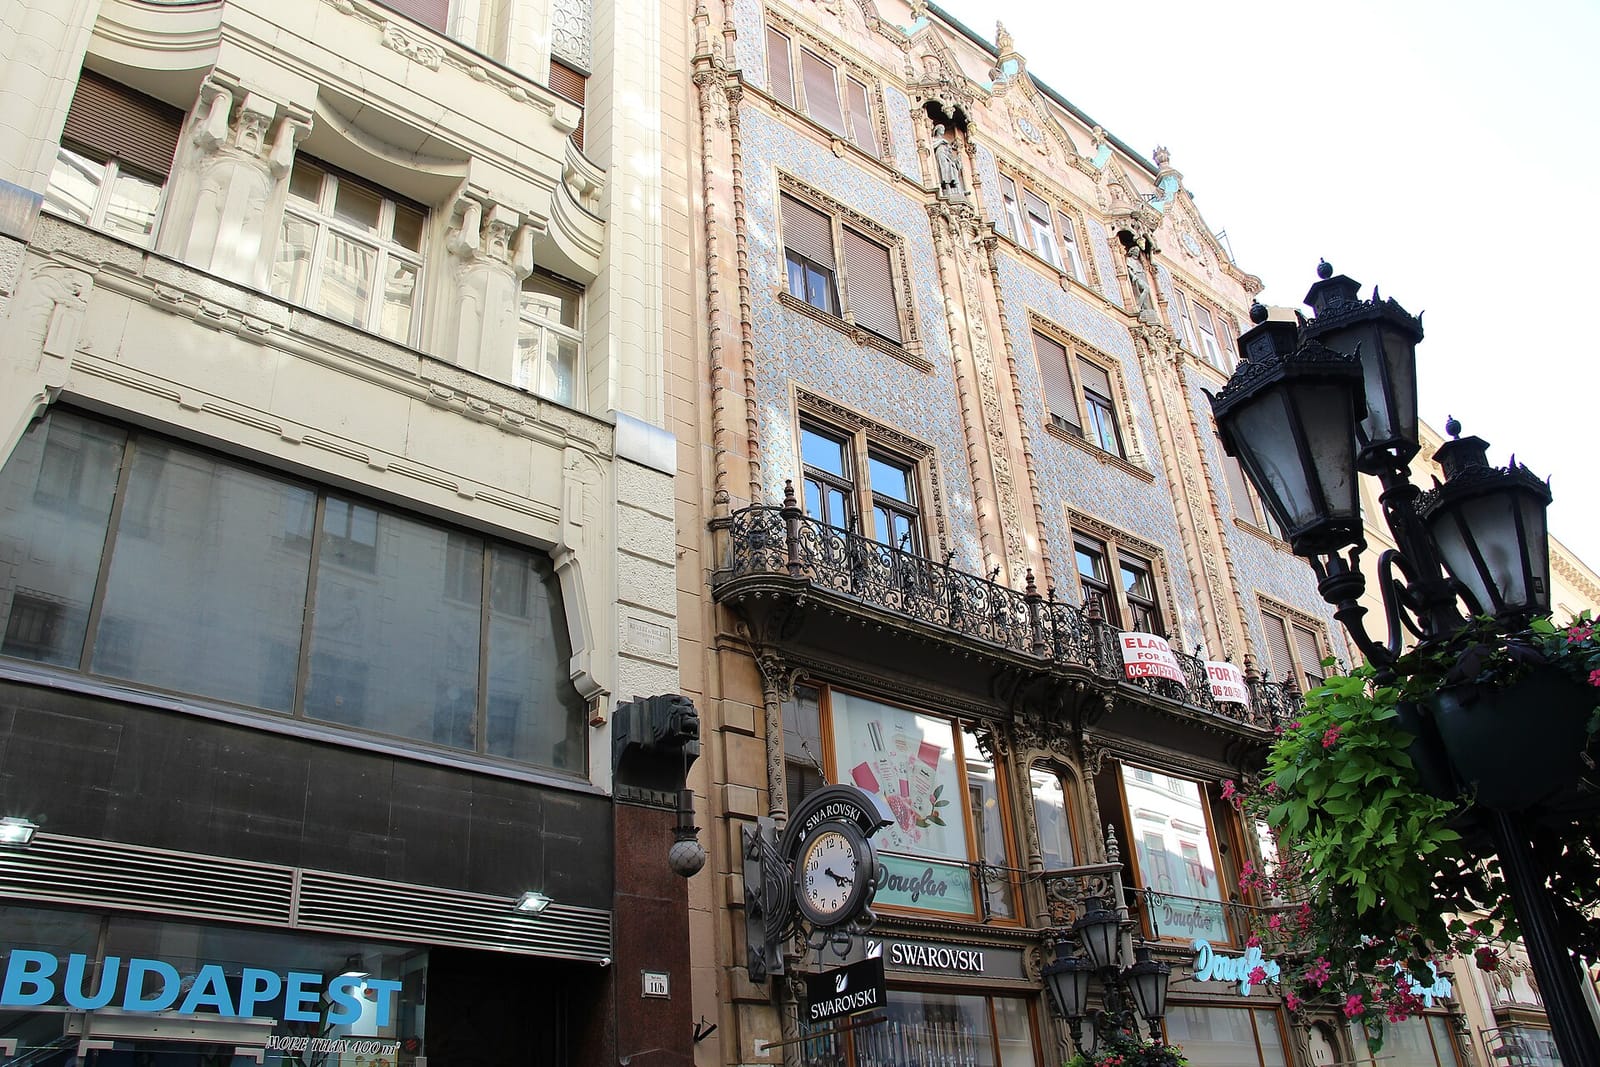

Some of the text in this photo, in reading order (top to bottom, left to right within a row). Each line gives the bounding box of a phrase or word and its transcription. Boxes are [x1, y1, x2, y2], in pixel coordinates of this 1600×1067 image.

[1124, 638, 1168, 653] ELAD
[1137, 652, 1159, 661] FOR
[1207, 667, 1231, 681] FOR
[806, 803, 861, 831] SWAROVSKI
[826, 839, 835, 849] 12
[840, 840, 844, 849] 1
[816, 848, 823, 857] 11
[846, 848, 853, 858] 2
[810, 861, 819, 871] 10
[808, 876, 814, 885] 9
[875, 863, 947, 902] Douglas
[812, 889, 818, 899] 8
[842, 892, 848, 900] 5
[821, 898, 826, 908] 7
[831, 899, 837, 909] 6
[891, 944, 985, 972] SWAROVSKI
[1, 949, 403, 1027] BUDAPEST
[811, 988, 877, 1019] SWAROVSKI
[265, 1035, 309, 1050] MORE
[311, 1037, 351, 1053] THAN
[351, 1041, 381, 1054] 400
